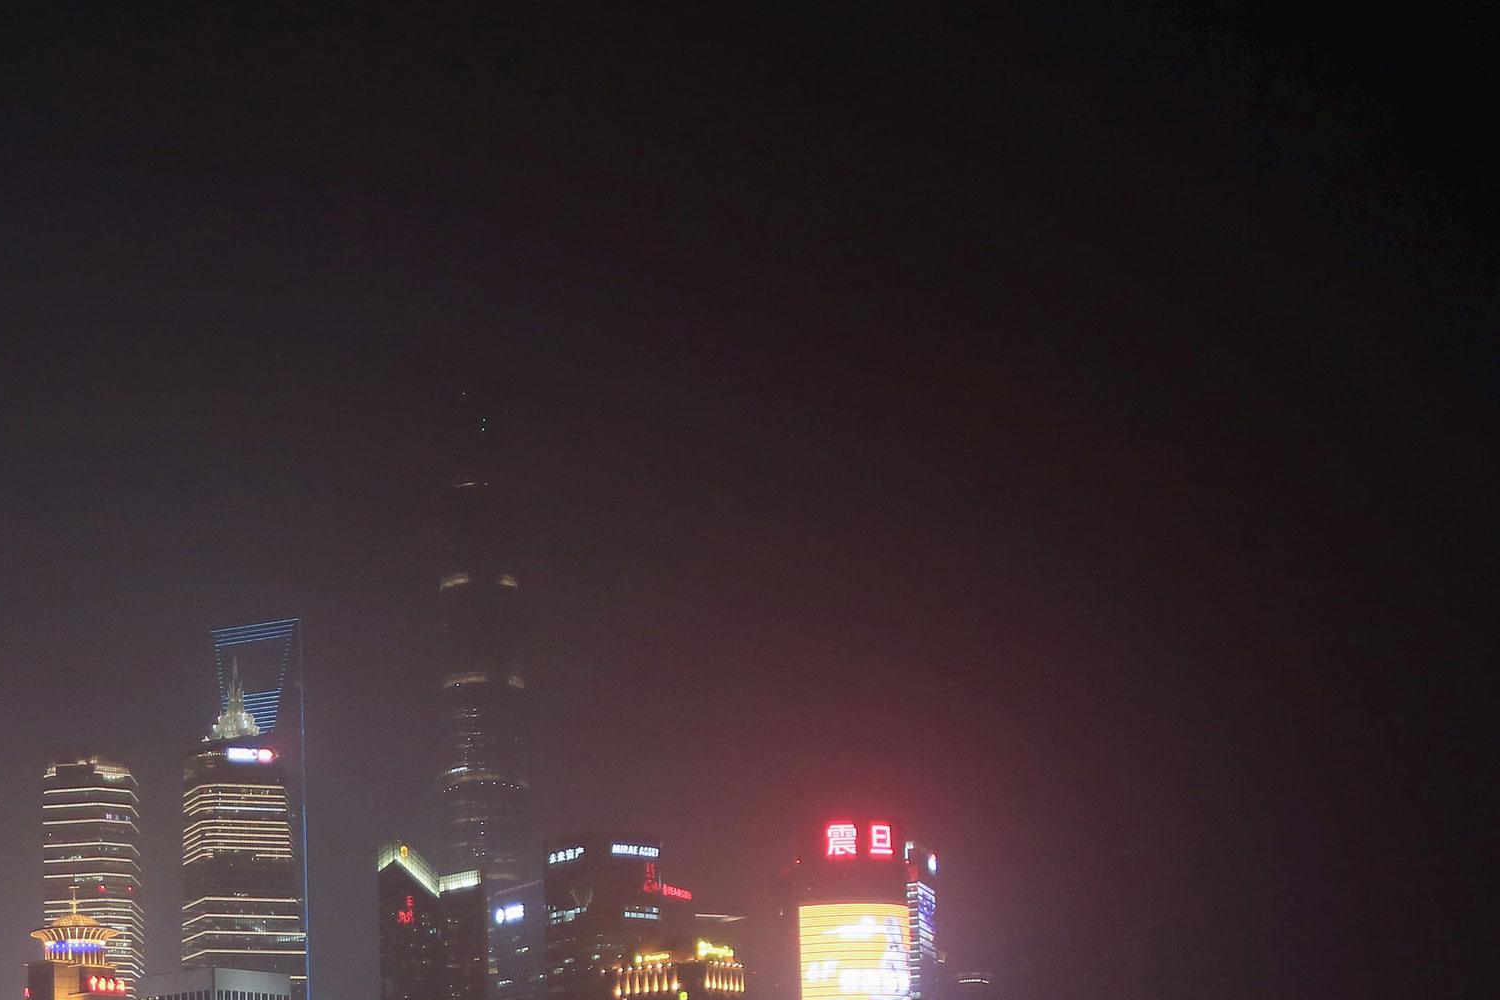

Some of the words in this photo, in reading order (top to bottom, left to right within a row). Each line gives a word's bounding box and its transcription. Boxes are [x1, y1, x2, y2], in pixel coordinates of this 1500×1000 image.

[826, 824, 894, 856] 震旦
[549, 847, 585, 864] 未来资产
[612, 844, 638, 855] MIRAE
[639, 846, 660, 858] ASSET
